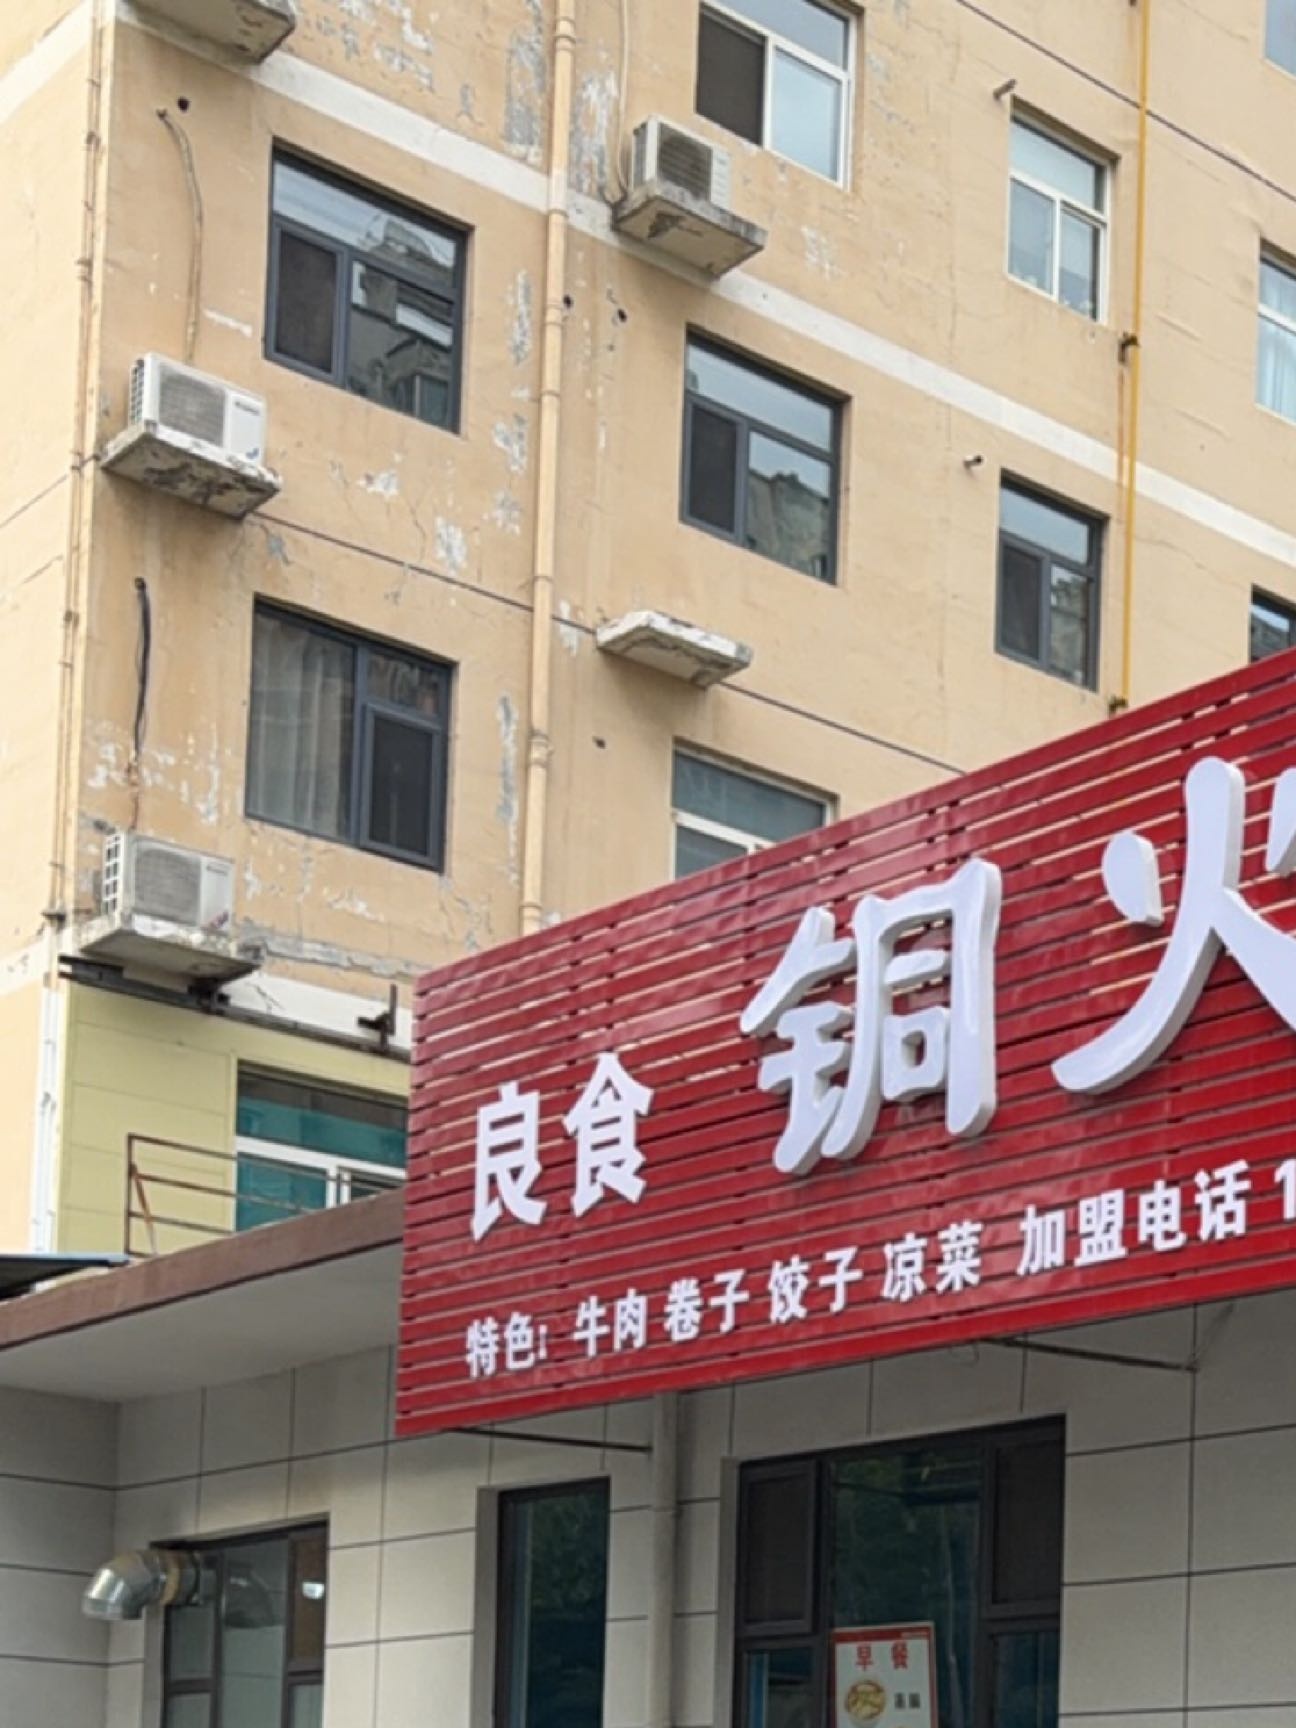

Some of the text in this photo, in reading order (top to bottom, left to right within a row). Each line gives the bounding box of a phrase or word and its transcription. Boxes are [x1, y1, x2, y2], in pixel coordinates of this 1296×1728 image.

[471, 1050, 655, 1241] 良食
[573, 1287, 649, 1357] 牛肉
[768, 1245, 863, 1324] 饺子
[882, 1219, 984, 1302] 凉菜
[1017, 1160, 1252, 1276] 加盟电话
